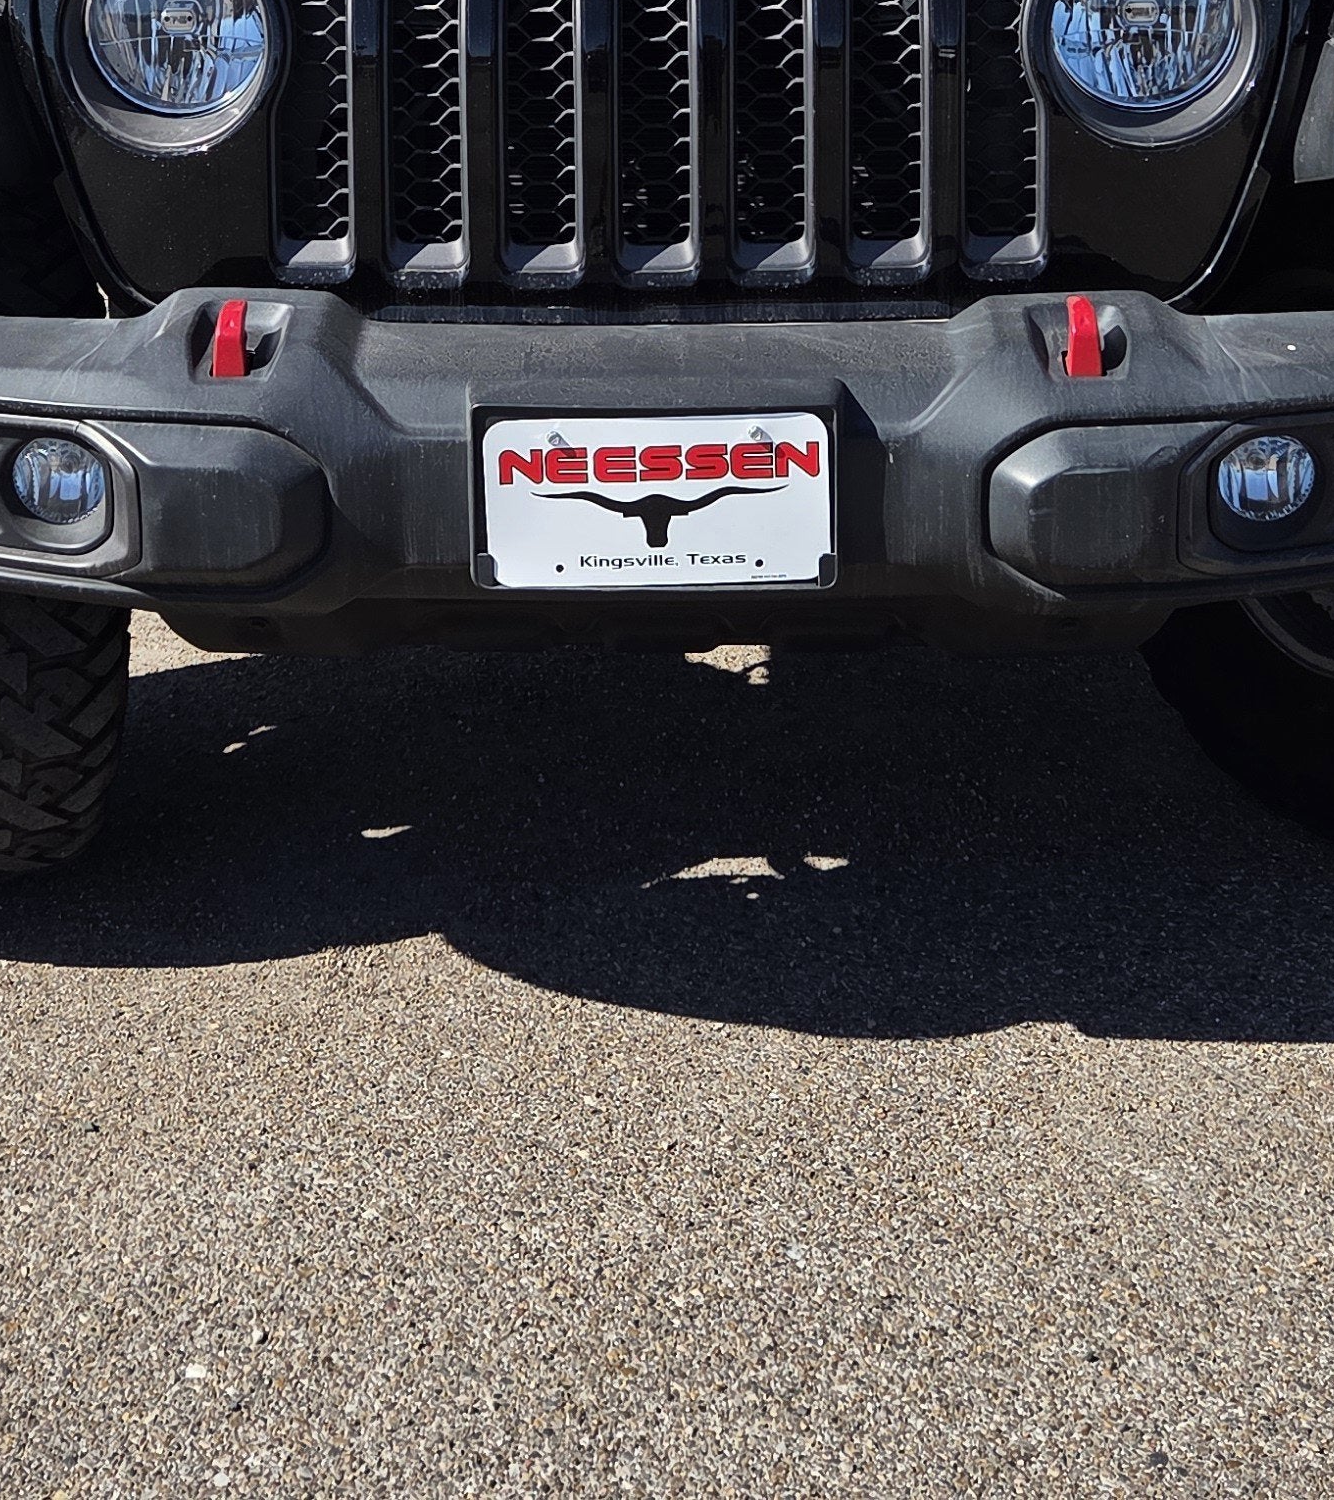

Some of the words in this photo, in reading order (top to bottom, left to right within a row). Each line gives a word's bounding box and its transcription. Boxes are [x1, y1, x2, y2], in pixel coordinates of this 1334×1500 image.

[498, 441, 820, 485] NEESSEN
[579, 553, 679, 570] Kingsville,
[686, 553, 746, 565] Texas
